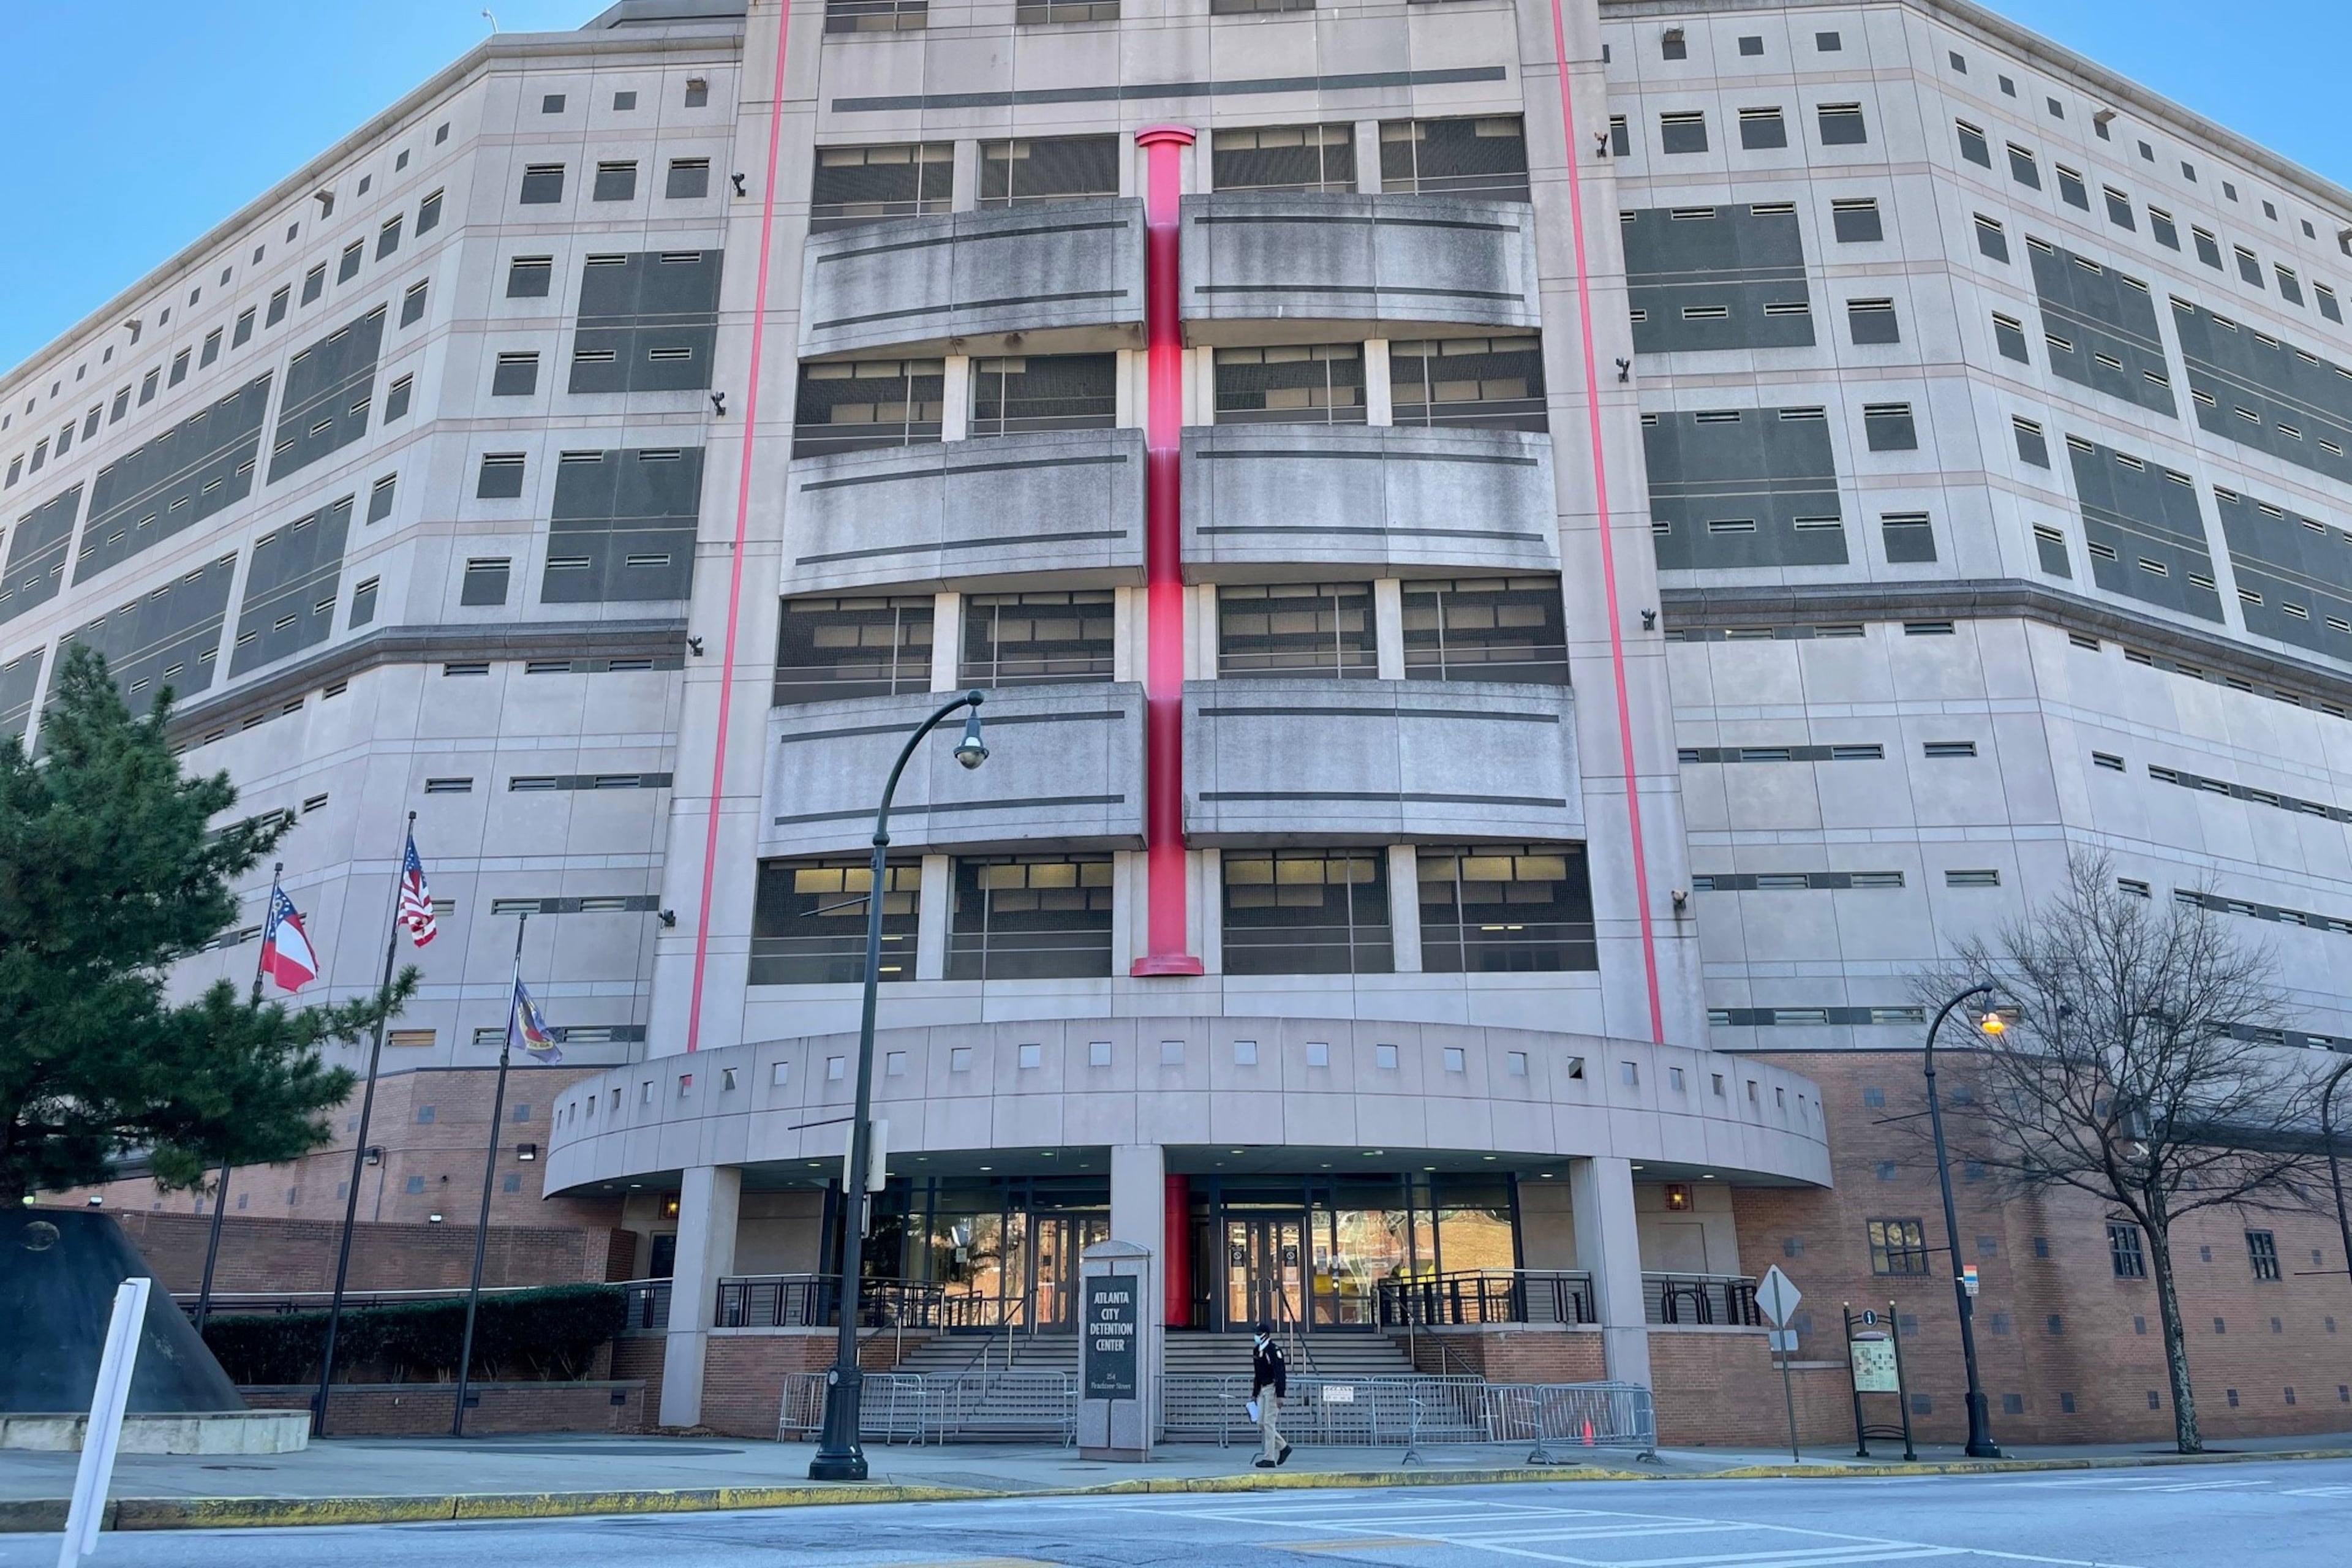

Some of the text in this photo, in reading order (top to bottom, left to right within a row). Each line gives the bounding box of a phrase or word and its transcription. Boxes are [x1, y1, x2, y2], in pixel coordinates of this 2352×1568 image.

[1094, 1292, 1129, 1304] ATLANTA
[1101, 1308, 1120, 1320] CITY
[1090, 1323, 1133, 1335] DETENTION
[1096, 1339, 1125, 1351] CENTER
